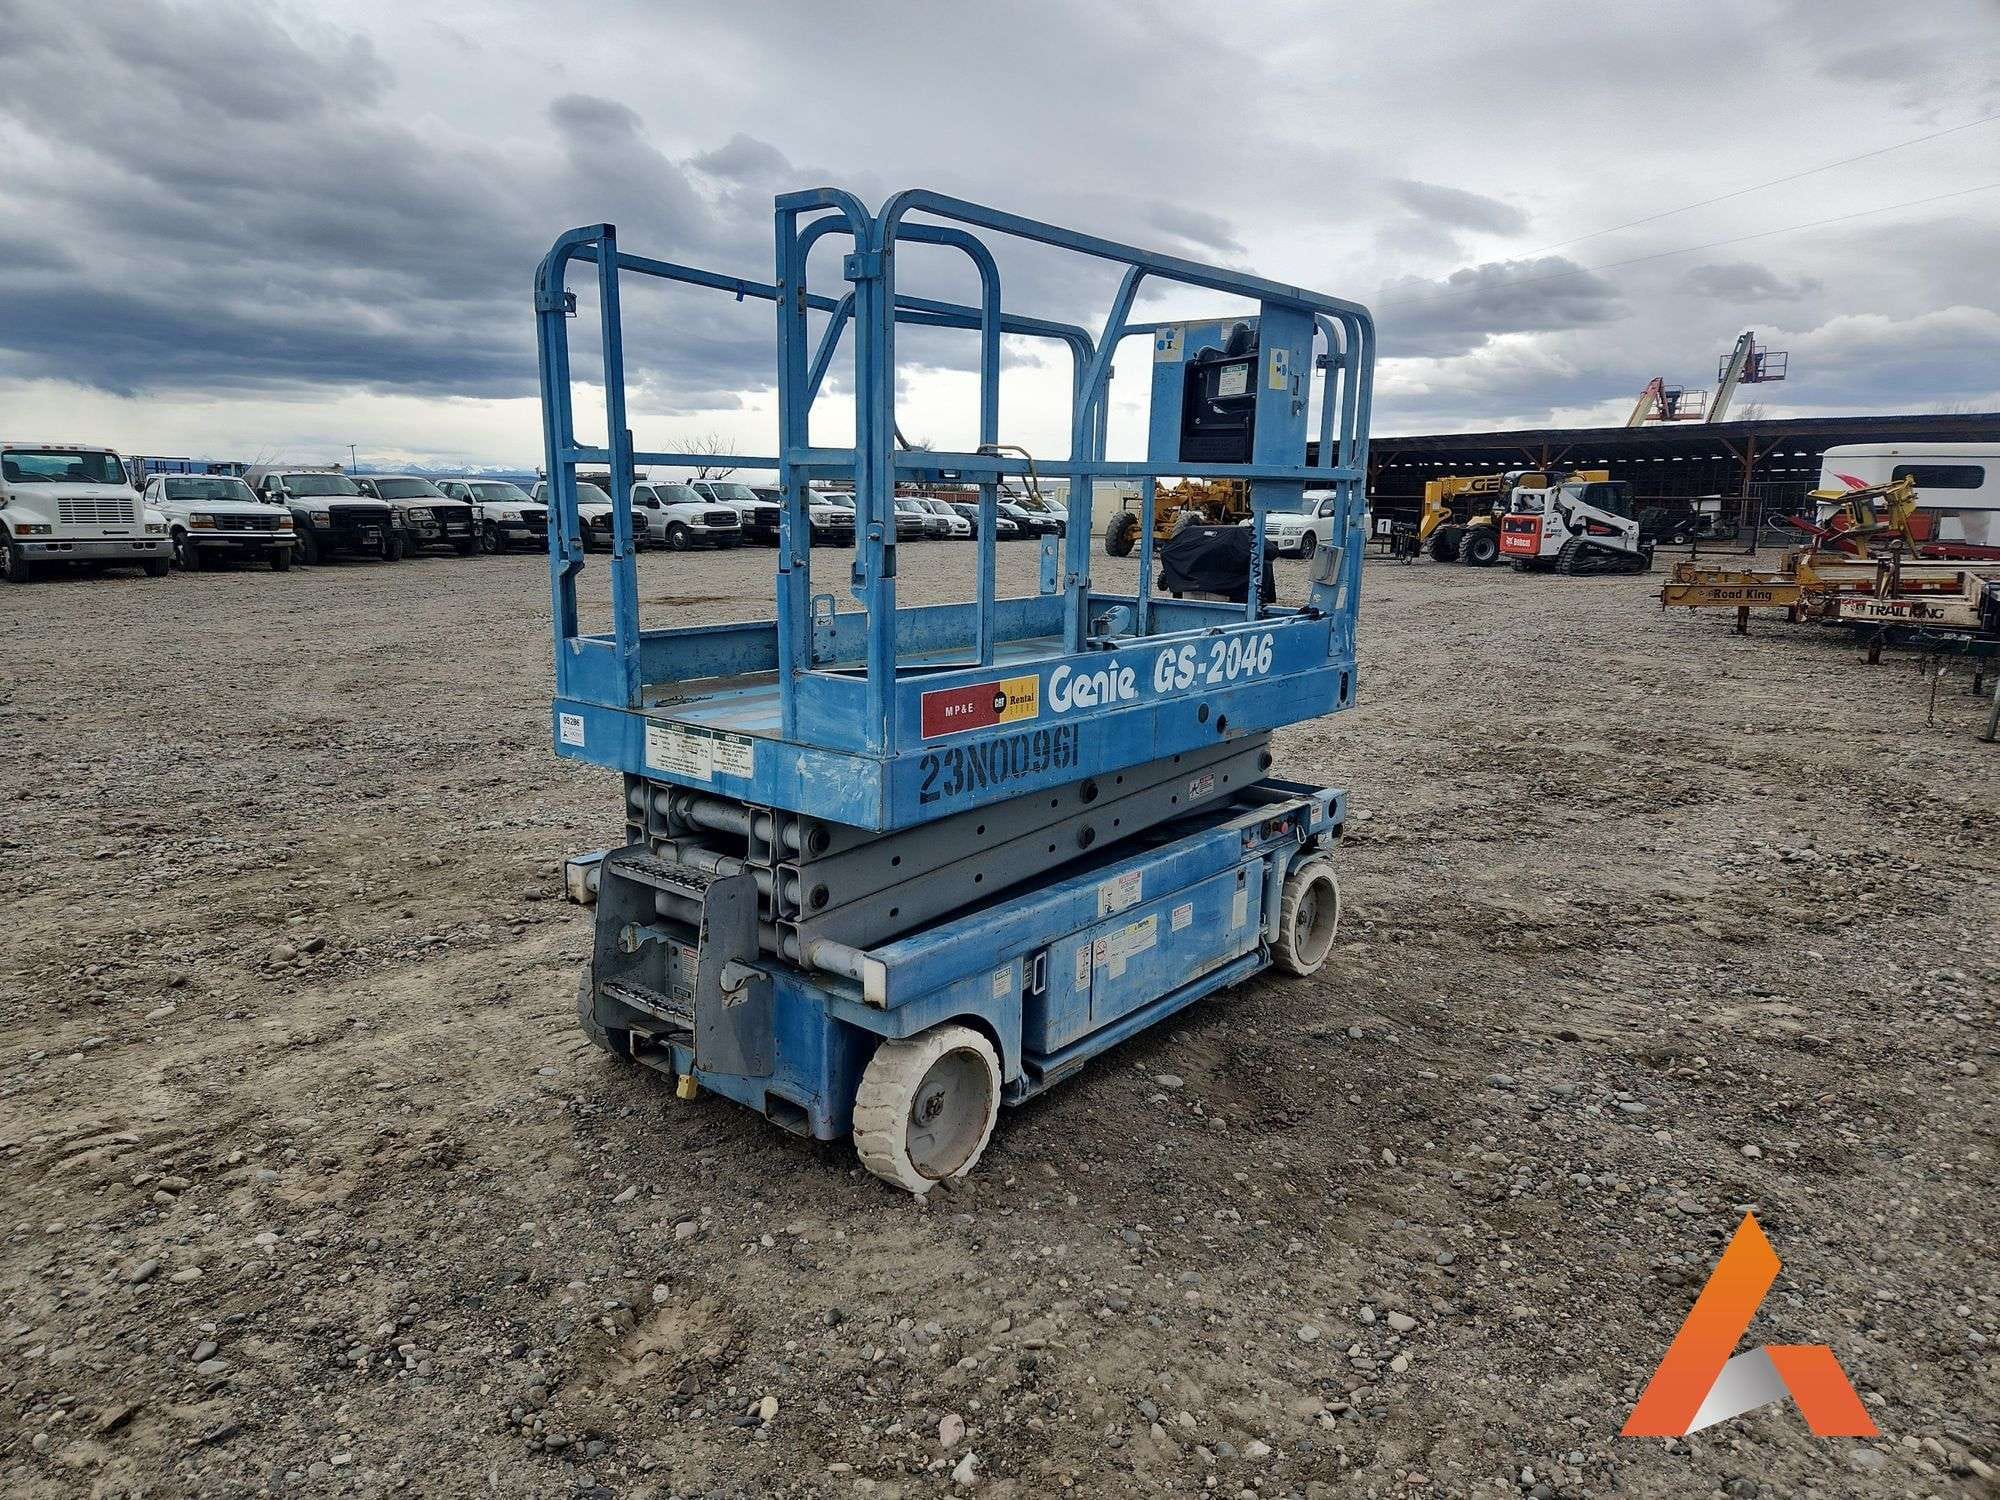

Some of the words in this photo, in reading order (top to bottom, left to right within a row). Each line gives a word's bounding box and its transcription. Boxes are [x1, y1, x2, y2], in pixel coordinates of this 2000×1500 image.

[1713, 588, 1742, 599] Road
[1747, 588, 1772, 601] King
[1867, 604, 1908, 618] TRAIL
[1049, 658, 1136, 713] Genie
[1154, 633, 1274, 693] GS-2046
[1010, 692, 1034, 705] Rental
